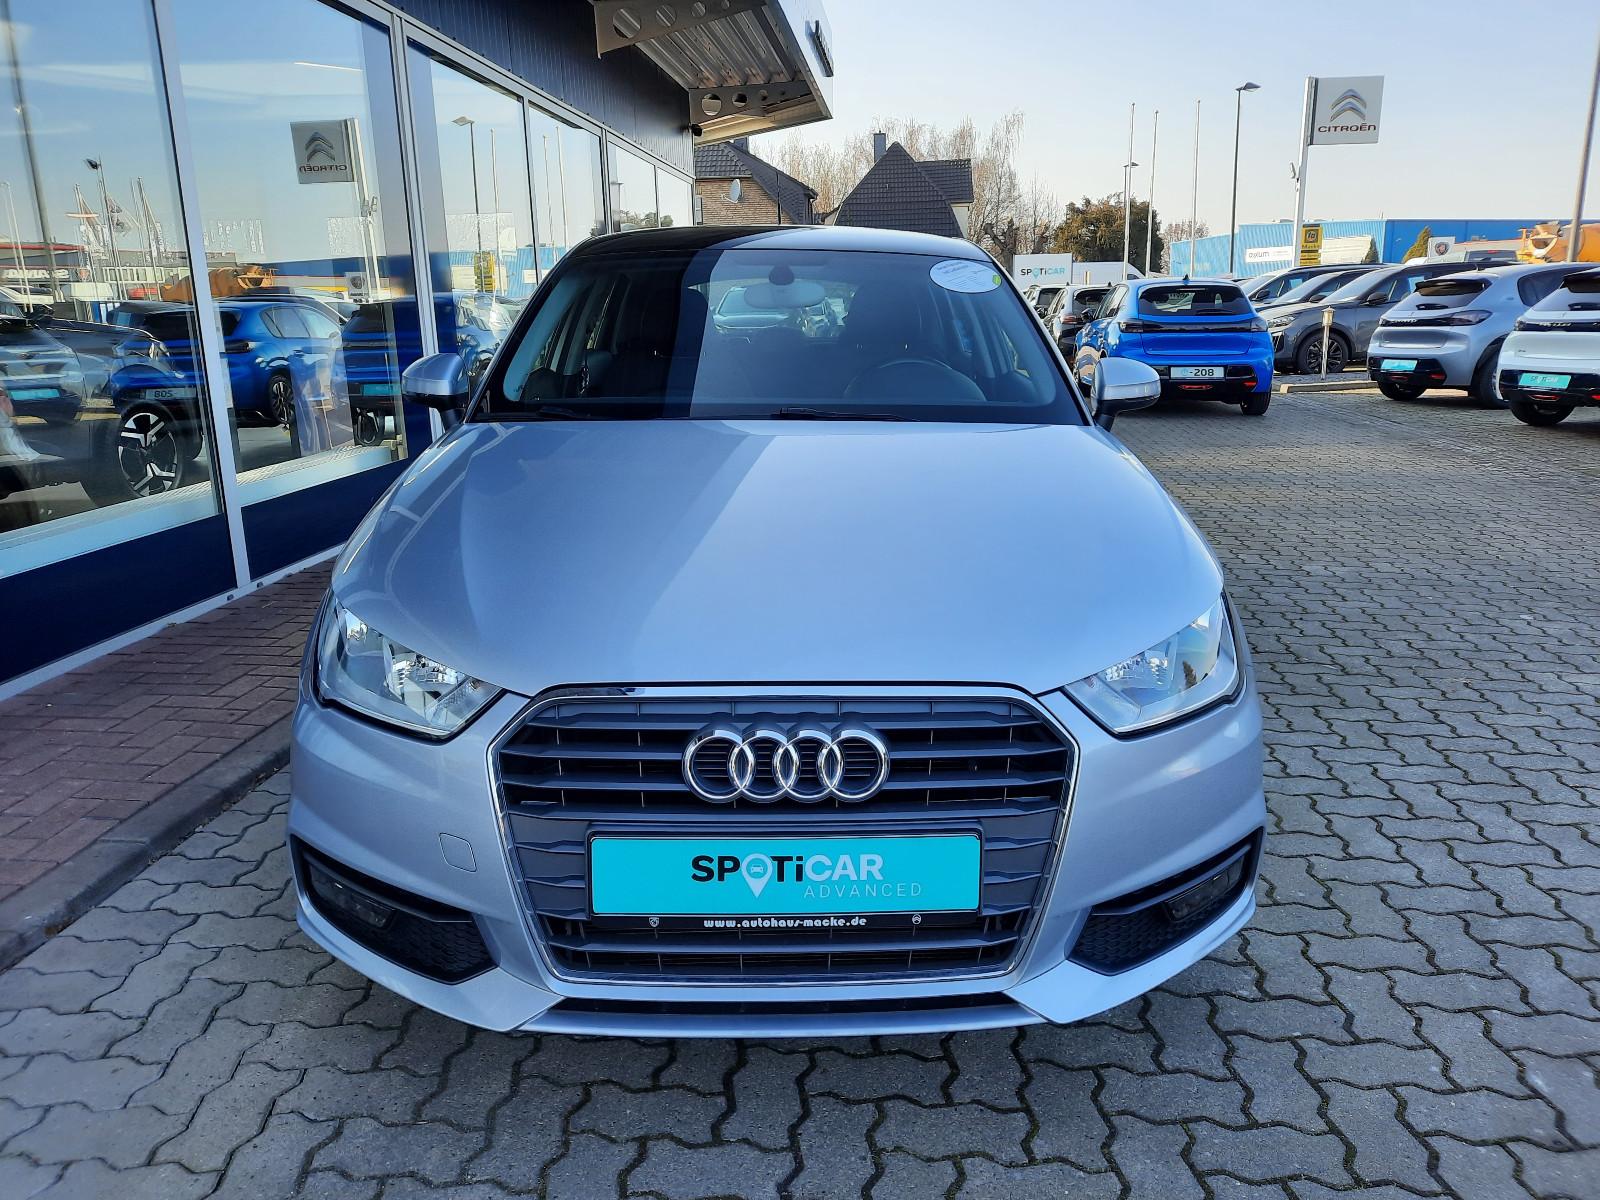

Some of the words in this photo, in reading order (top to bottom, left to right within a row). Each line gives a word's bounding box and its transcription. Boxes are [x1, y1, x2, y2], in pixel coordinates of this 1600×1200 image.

[1318, 123, 1376, 132] CITROËN
[691, 854, 884, 898] SPOTiCAR
[804, 883, 922, 898] ADVANCED
[703, 916, 867, 928] www.autohaus-macke.de
